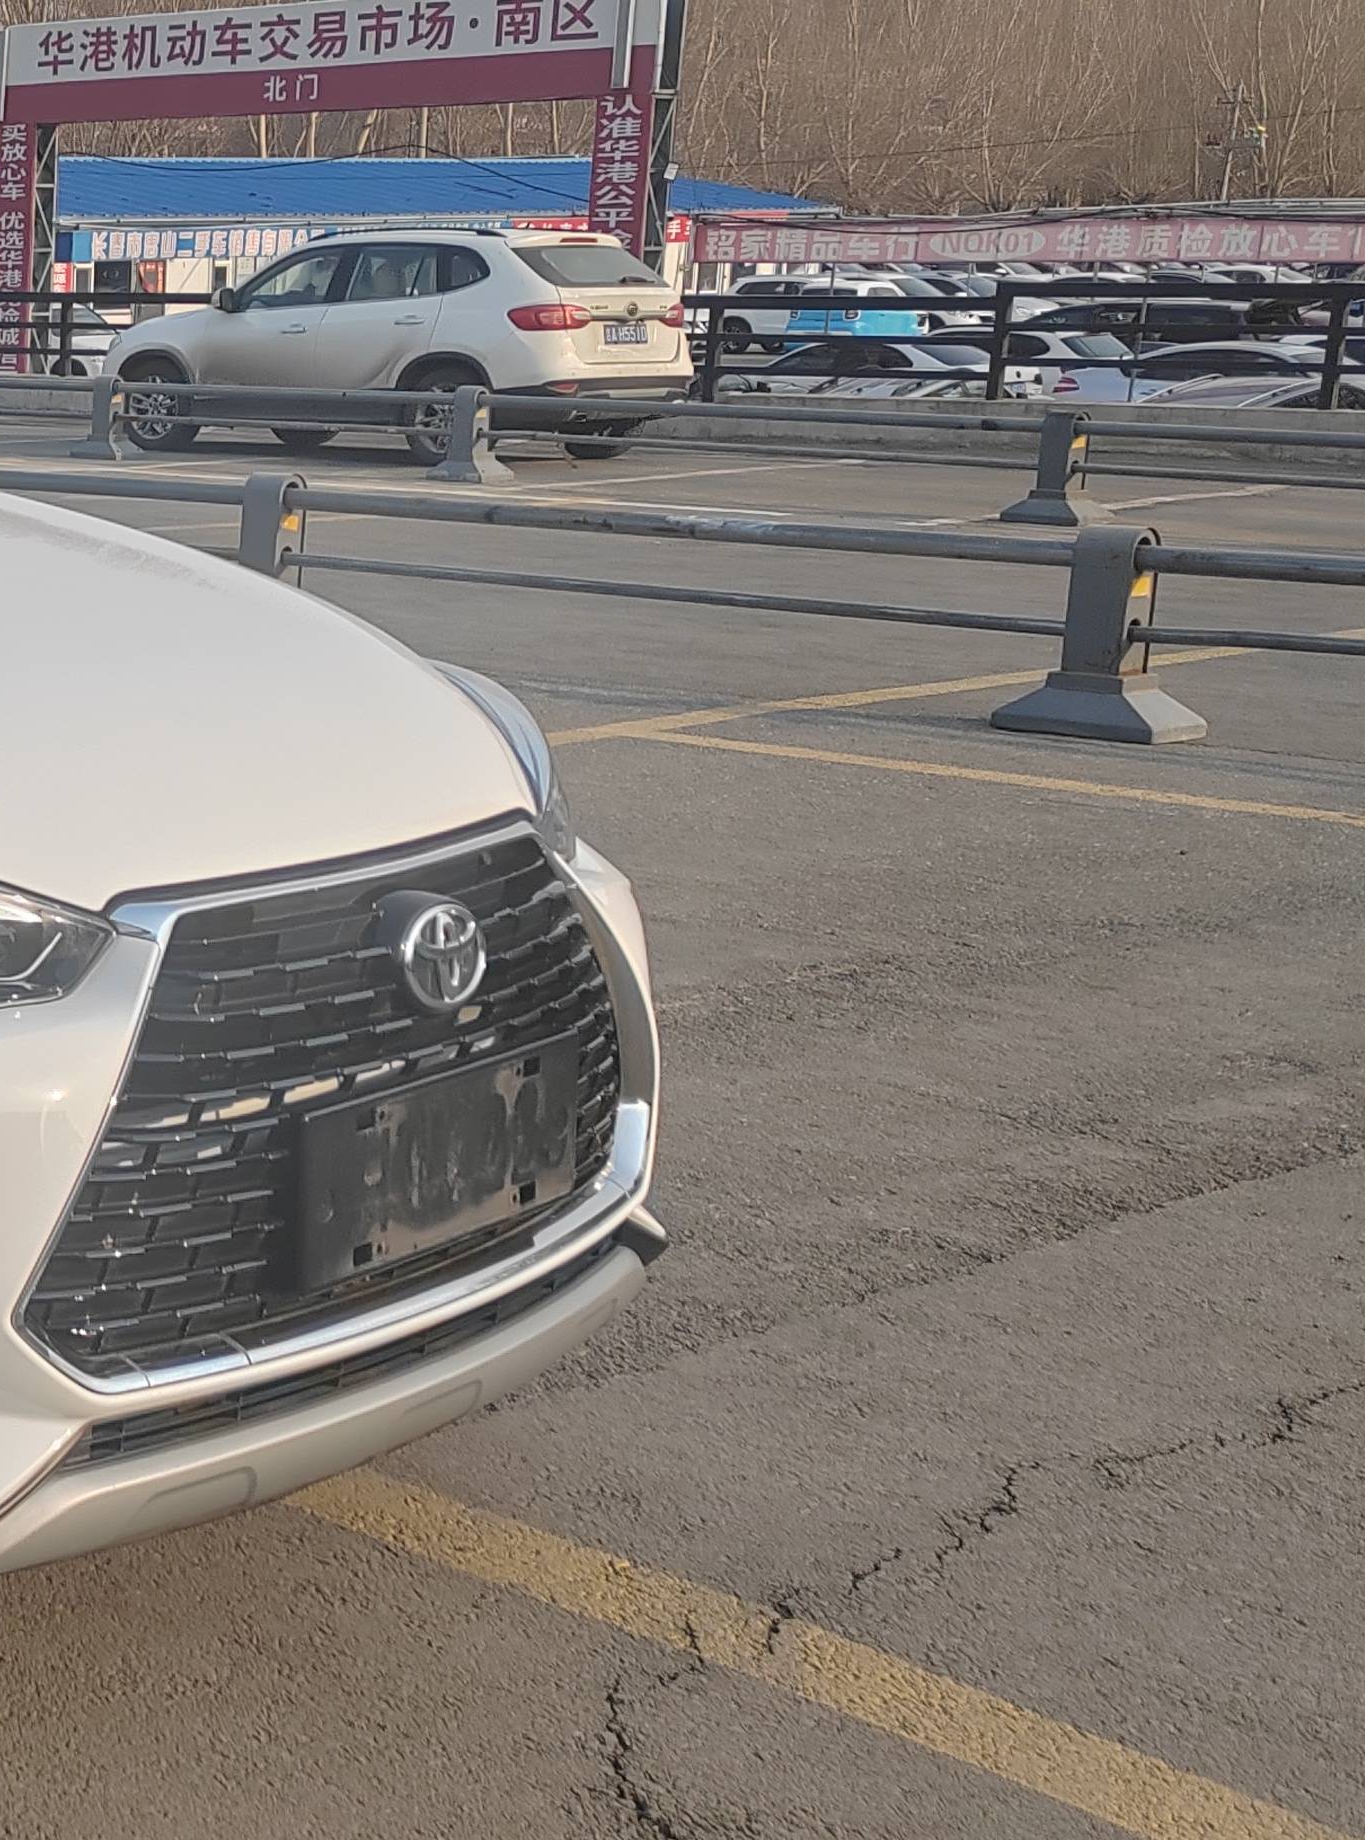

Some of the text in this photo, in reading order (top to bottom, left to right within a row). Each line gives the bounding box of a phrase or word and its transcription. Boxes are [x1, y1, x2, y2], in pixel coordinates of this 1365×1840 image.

[38, 0, 599, 76] 华港机动车交易市场·南区
[263, 74, 319, 101] 北门
[0, 124, 27, 200] 买放心车
